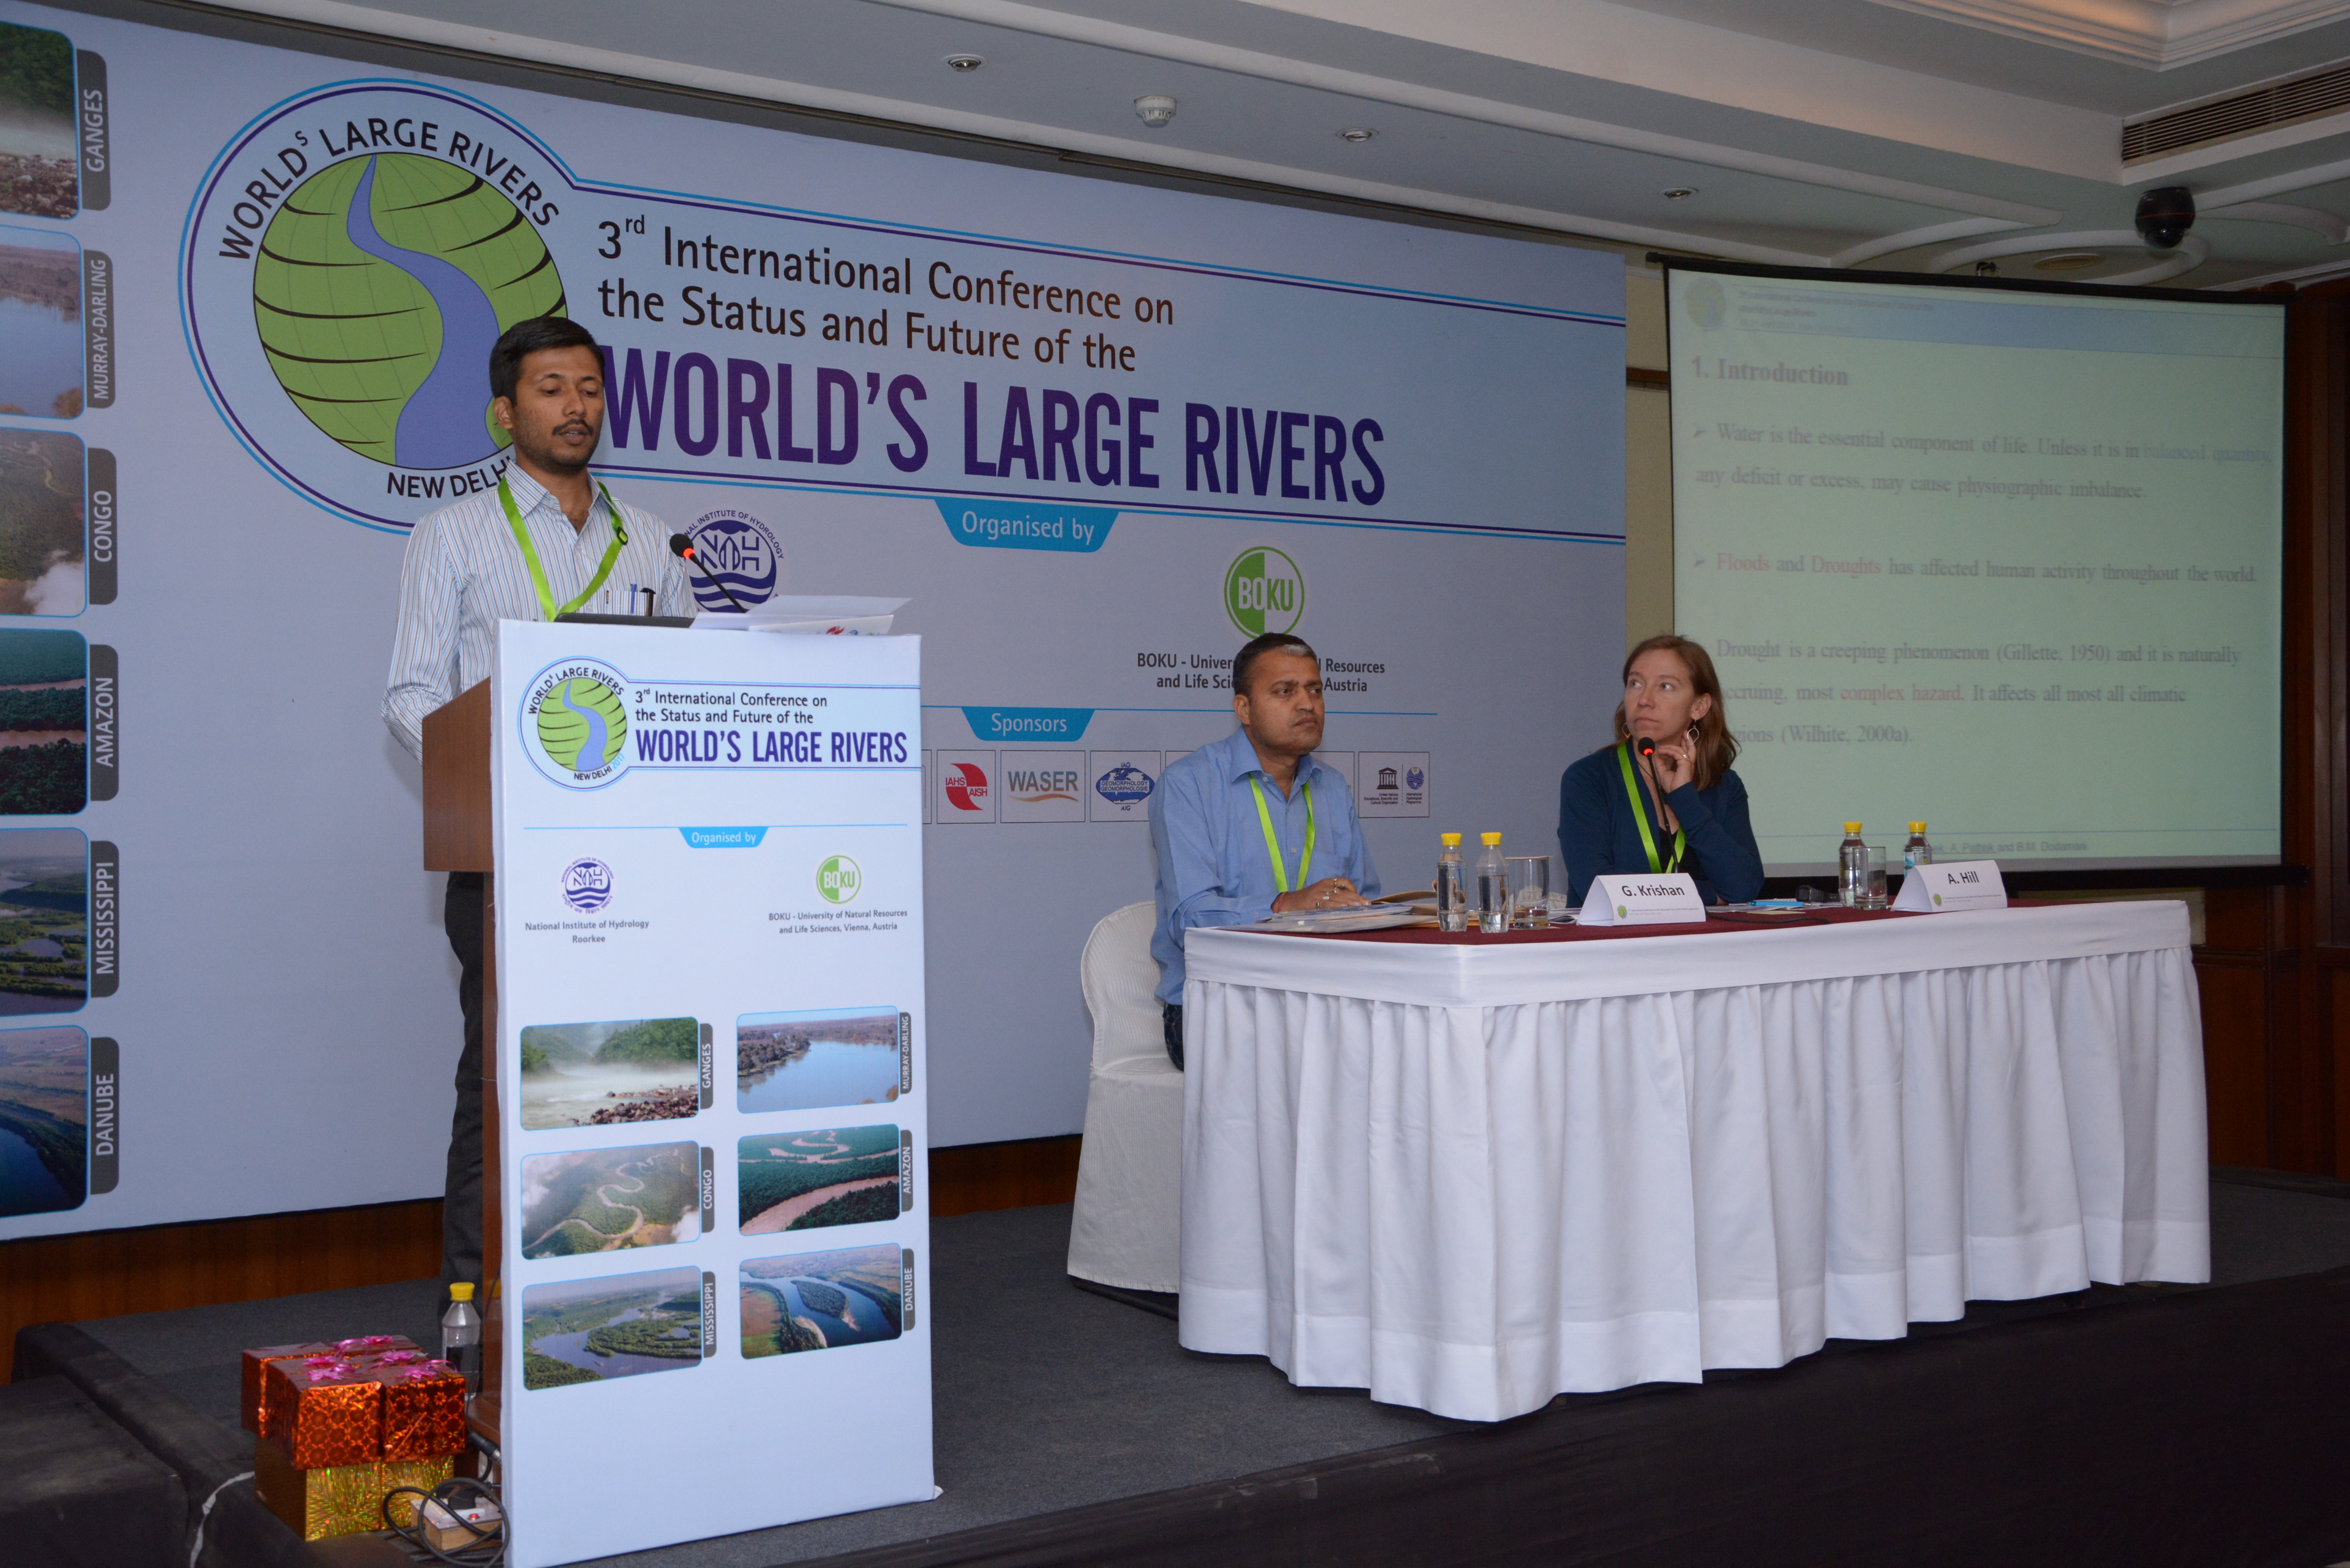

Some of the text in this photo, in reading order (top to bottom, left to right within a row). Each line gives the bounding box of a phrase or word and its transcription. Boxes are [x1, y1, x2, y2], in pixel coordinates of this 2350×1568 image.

[84, 88, 105, 172] GANGES
[319, 118, 438, 157] LARGE
[449, 131, 559, 225] RIVERS
[598, 215, 1173, 325] 3rd International Conference on
[91, 259, 109, 399] MURRAY-DARLING
[598, 278, 1136, 372] the Status and Future of the
[1691, 355, 1848, 386] 1. Introduction
[601, 345, 1385, 506] WORLD'S LARGE RIVERS
[1717, 423, 1764, 442] Water
[1771, 425, 1783, 443] is
[1788, 426, 1812, 444] the
[1818, 430, 1884, 448] essential
[1891, 435, 1974, 454] component
[1982, 436, 1997, 453] of
[2038, 437, 2087, 456] Unless
[2093, 440, 2103, 456] it
[2108, 441, 2119, 457] is
[2125, 442, 2139, 459] in
[387, 472, 444, 498] NEW
[1695, 467, 2146, 499] any deficit or excess, may cause physiographic imbalance.
[94, 490, 112, 562] CONGO
[697, 510, 736, 525] INSTITUTE
[750, 516, 784, 559] HYDROLOGY
[963, 511, 1094, 546] Organised by
[1717, 553, 2257, 585] Floods and Droughts has affected human activity throughout the world.
[1238, 577, 1293, 612] BOKU
[1137, 653, 1177, 668] BOKU
[1326, 658, 1385, 673] Resources
[1717, 639, 2240, 667] Drought is a creeping phenomenon (Gillette, 1950) and it is naturally
[555, 667, 589, 681] LARGE
[592, 670, 624, 695] RIVERS
[1157, 674, 1180, 688] and
[1185, 674, 1208, 688] Life
[1324, 678, 1367, 692] Austria
[1724, 683, 2186, 705] ccruing, most complex hazard. It affects all most all climatic
[636, 688, 827, 707] 3rd International Conference on
[96, 677, 113, 767] AMAZON
[636, 709, 813, 724] the Status and Future of the
[992, 712, 1067, 736] Sponsors
[636, 729, 907, 763] WORLD'S LARGE RIVERS
[1857, 725, 1913, 744] 2000a).
[574, 753, 625, 780] NEW DELHI 2017
[946, 777, 965, 786] IAHS
[1008, 771, 1078, 792] WASER
[969, 788, 987, 797] AISH
[692, 832, 756, 845] Organised by
[824, 871, 855, 889] BOKU
[1621, 884, 1685, 896] G. Krishan
[1948, 871, 1979, 884] A. Hill
[96, 862, 114, 974] MISSISSIPPI
[525, 922, 560, 930] National
[609, 920, 649, 929] Hydrology
[798, 912, 833, 920] University
[810, 925, 842, 933] Sciences,
[702, 1043, 711, 1089] GANGES
[96, 1073, 114, 1155] DANUBE
[903, 1146, 911, 1194] AMAZON
[704, 1169, 712, 1209] CONGO
[905, 1267, 913, 1311] DANUBE
[705, 1283, 714, 1346] MISSISSIPPI
